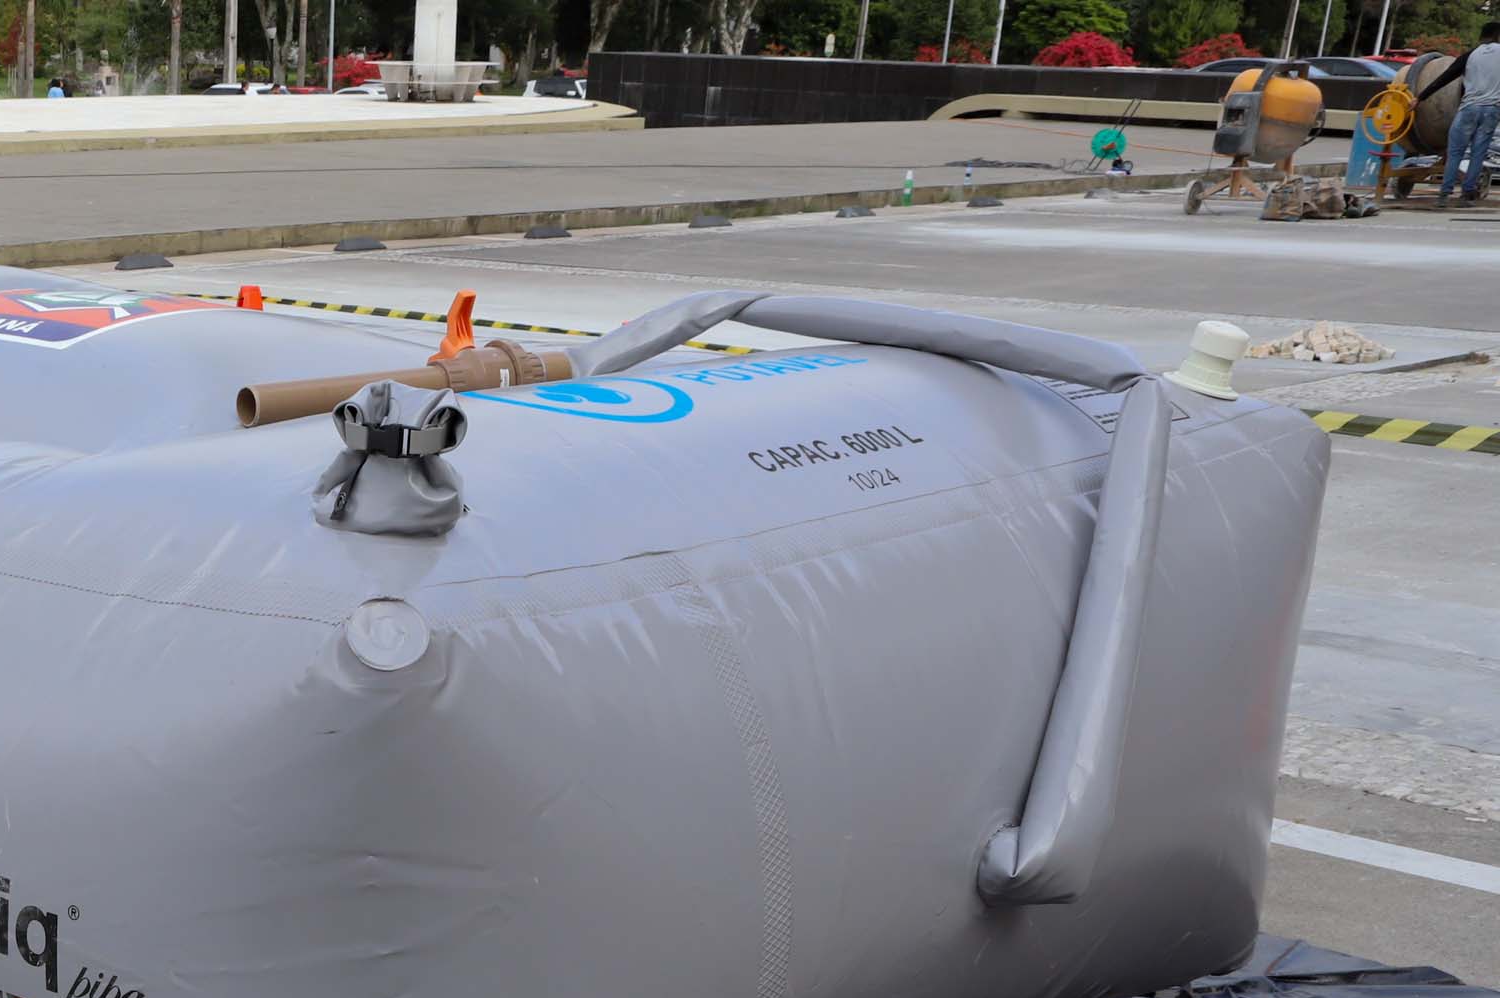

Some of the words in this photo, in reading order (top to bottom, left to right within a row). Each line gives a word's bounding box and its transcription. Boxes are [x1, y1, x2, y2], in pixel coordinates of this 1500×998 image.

[748, 439, 849, 472] CAPAC.
[841, 428, 894, 455] 6000
[893, 426, 924, 445] L
[848, 467, 901, 492] 10/24
